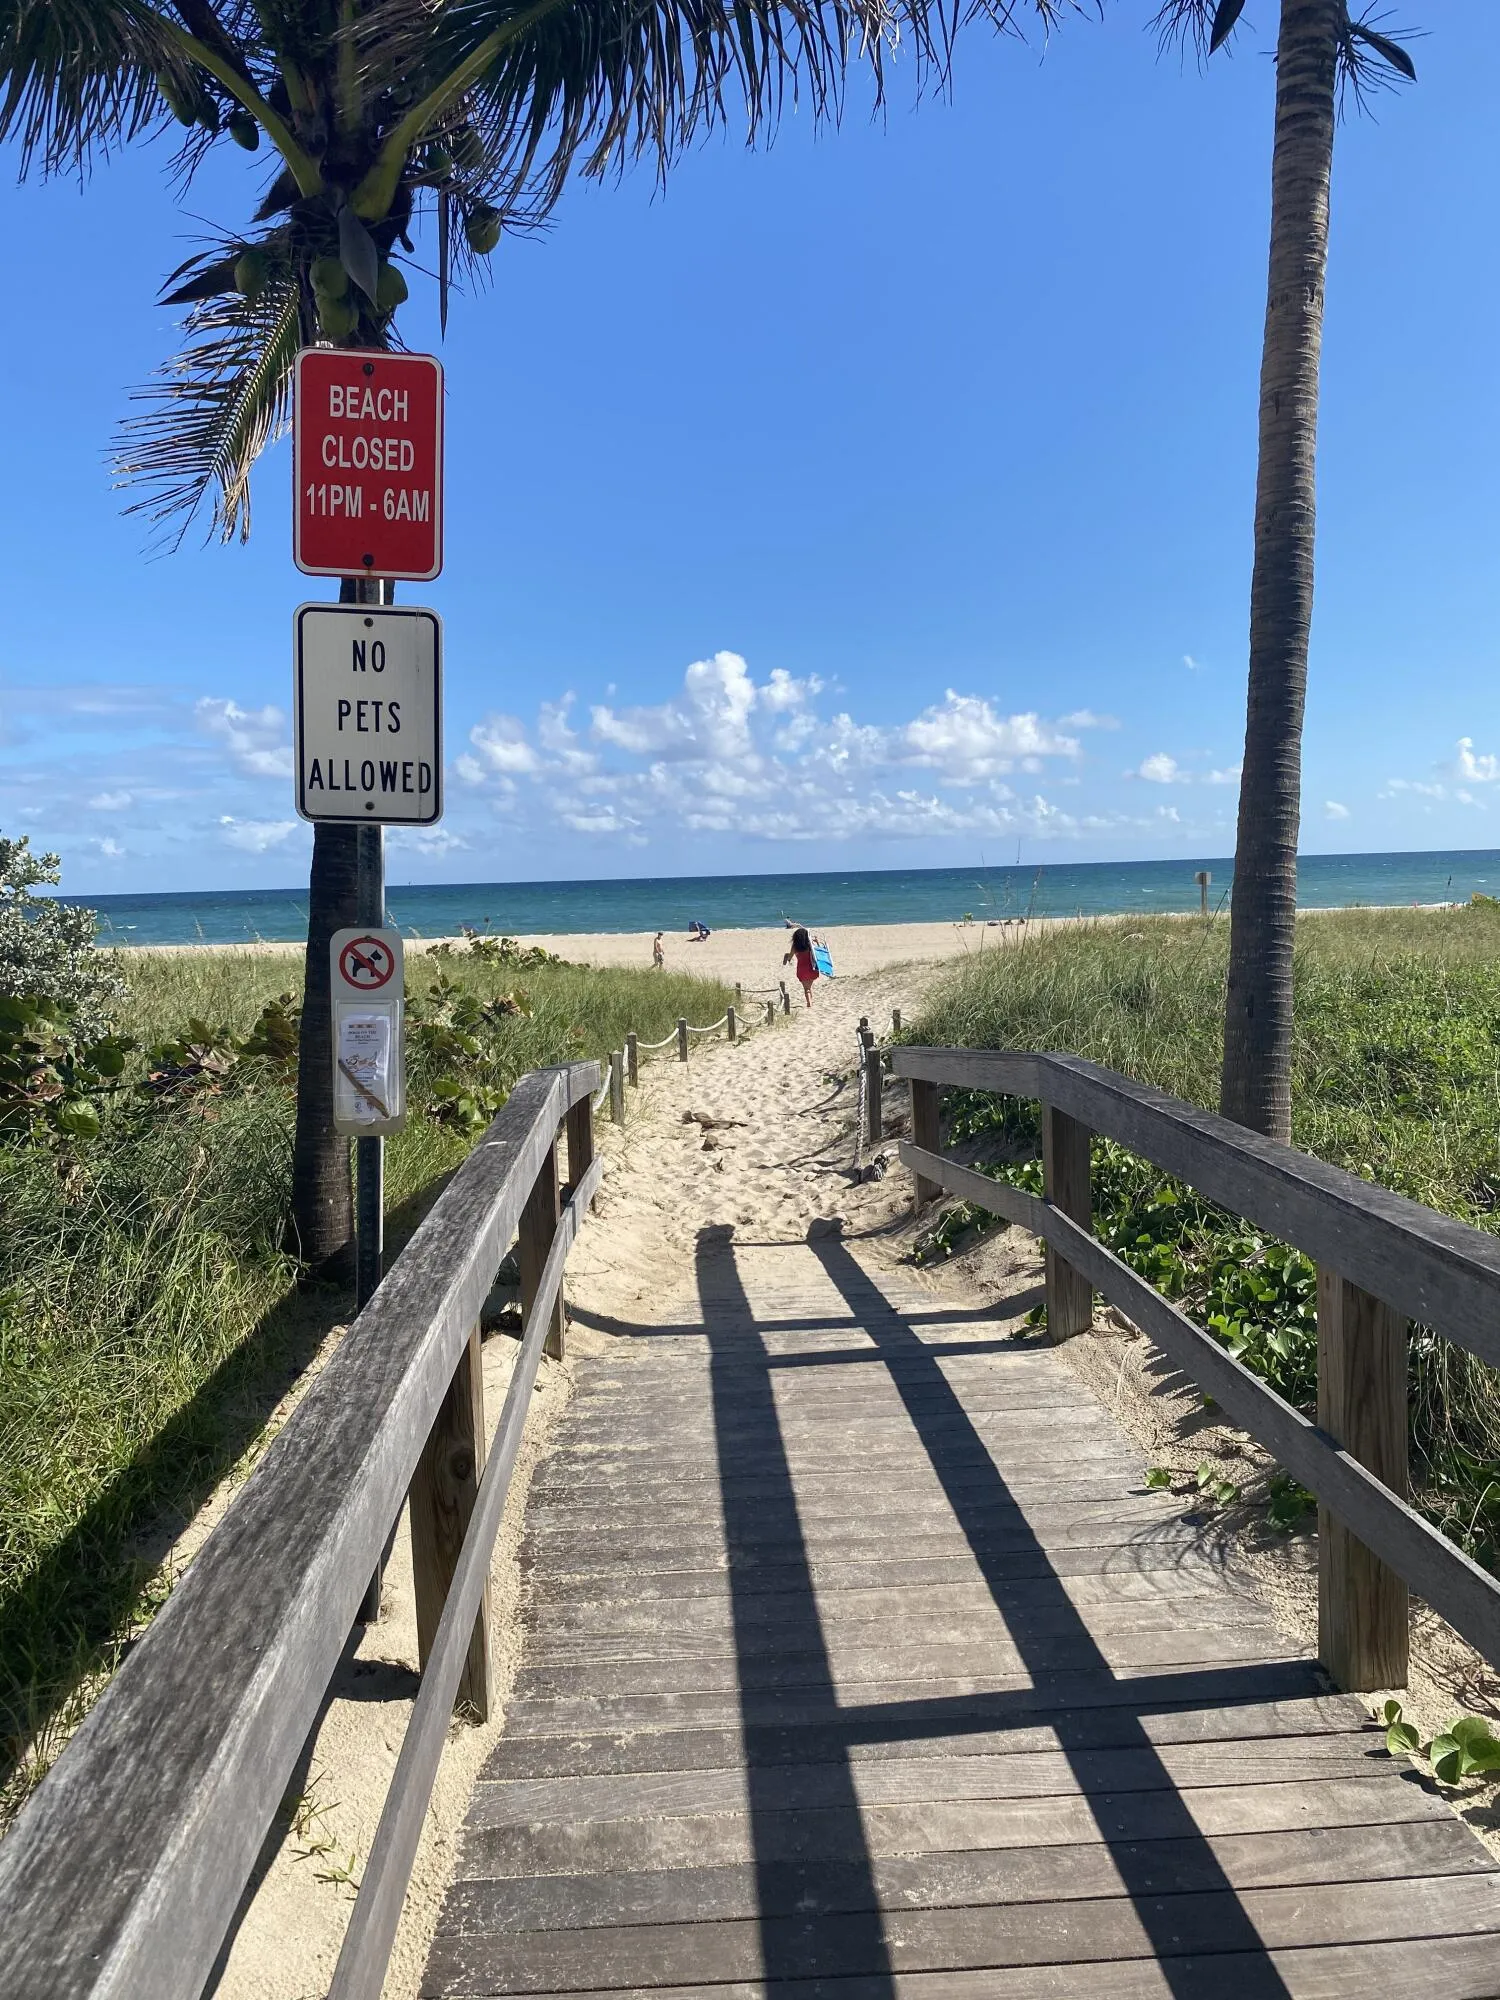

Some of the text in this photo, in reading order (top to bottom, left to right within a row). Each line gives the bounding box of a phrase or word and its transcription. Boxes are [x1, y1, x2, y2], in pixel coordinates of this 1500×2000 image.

[329, 385, 408, 422] BEACH
[322, 434, 415, 471] CLOSED
[306, 483, 362, 518] 11PM
[383, 488, 430, 522] 6AM
[352, 639, 386, 673] NO
[338, 699, 401, 733] PETS
[308, 758, 432, 794] ALLOWED
